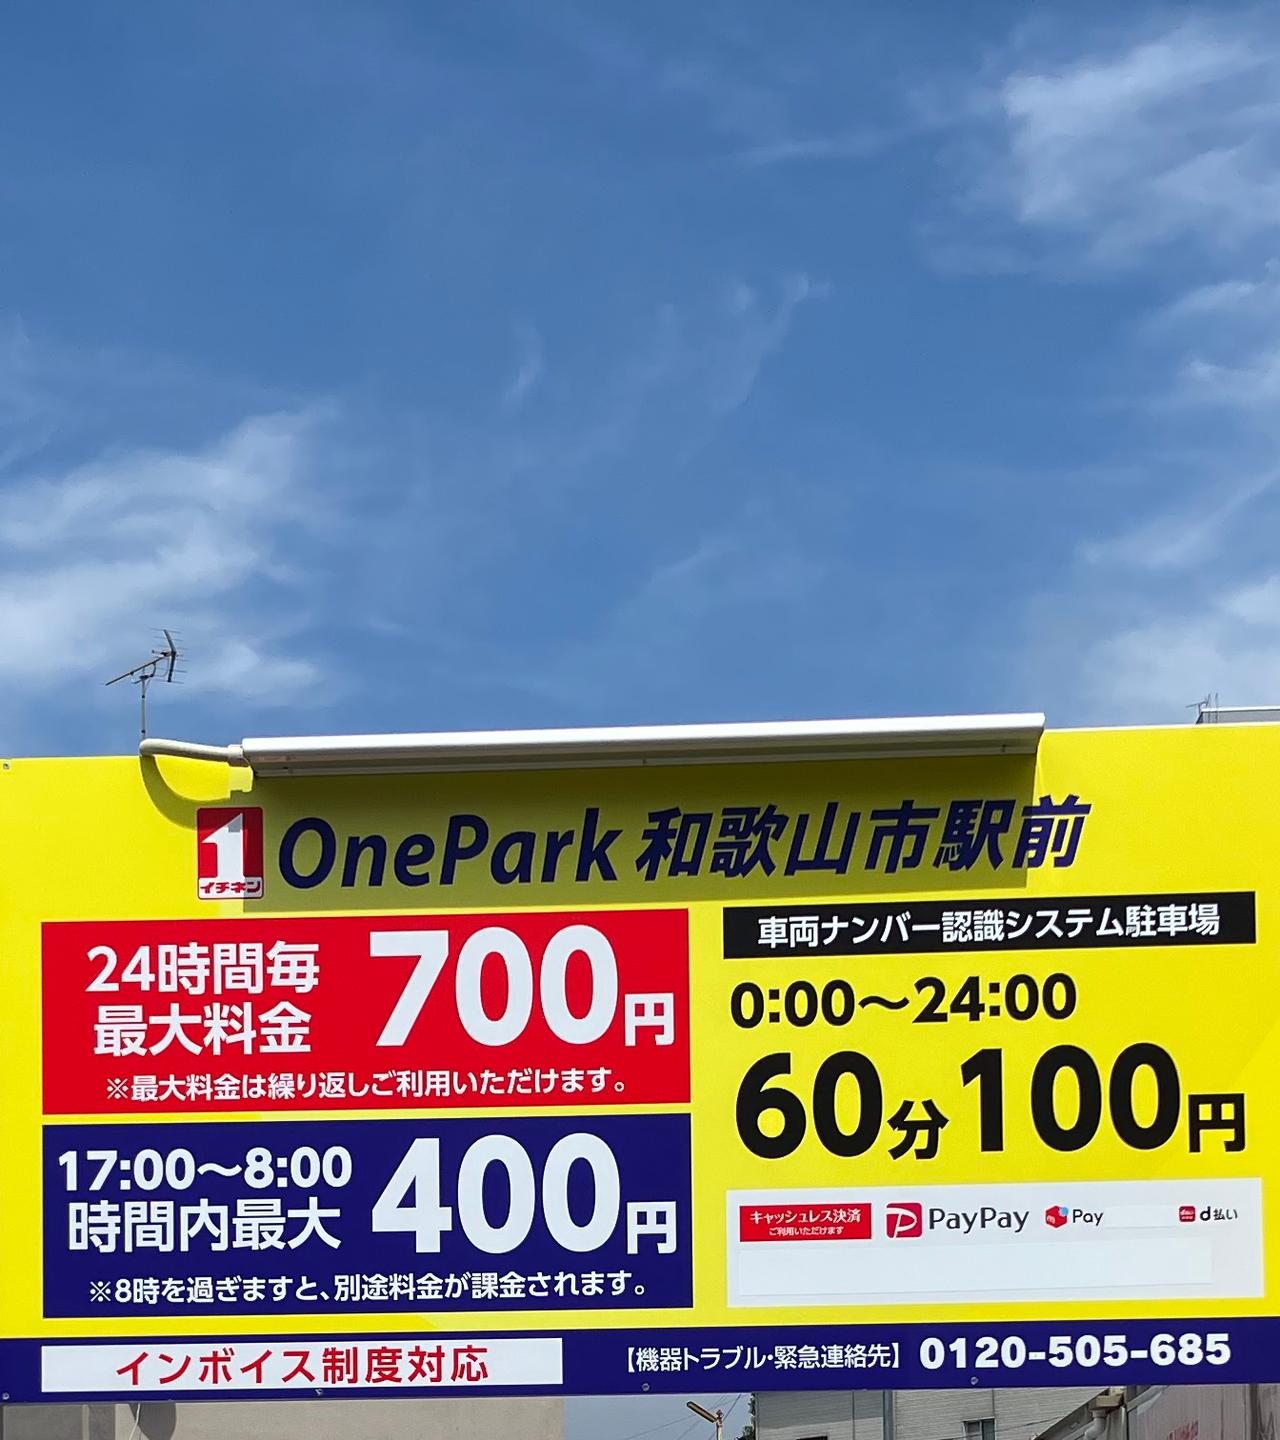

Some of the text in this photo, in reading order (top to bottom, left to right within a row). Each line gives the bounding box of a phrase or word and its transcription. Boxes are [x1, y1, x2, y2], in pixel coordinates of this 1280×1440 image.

[279, 794, 1091, 889] OnePark 和歌山市駅前
[758, 902, 1220, 947] 車両ナンバー認識システム駐車場
[85, 940, 320, 994] 24時間毎
[94, 1002, 312, 1056] 最大料金
[68, 1197, 341, 1253] 時間内最大
[750, 1208, 861, 1224] キャッシュレス決済
[929, 1206, 1029, 1234] PayPay
[1073, 1209, 1103, 1226] Pay
[1200, 1206, 1238, 1221] d払い
[116, 1345, 489, 1385] インボイス制度対応
[920, 1333, 1231, 1370] 0120-505-685
